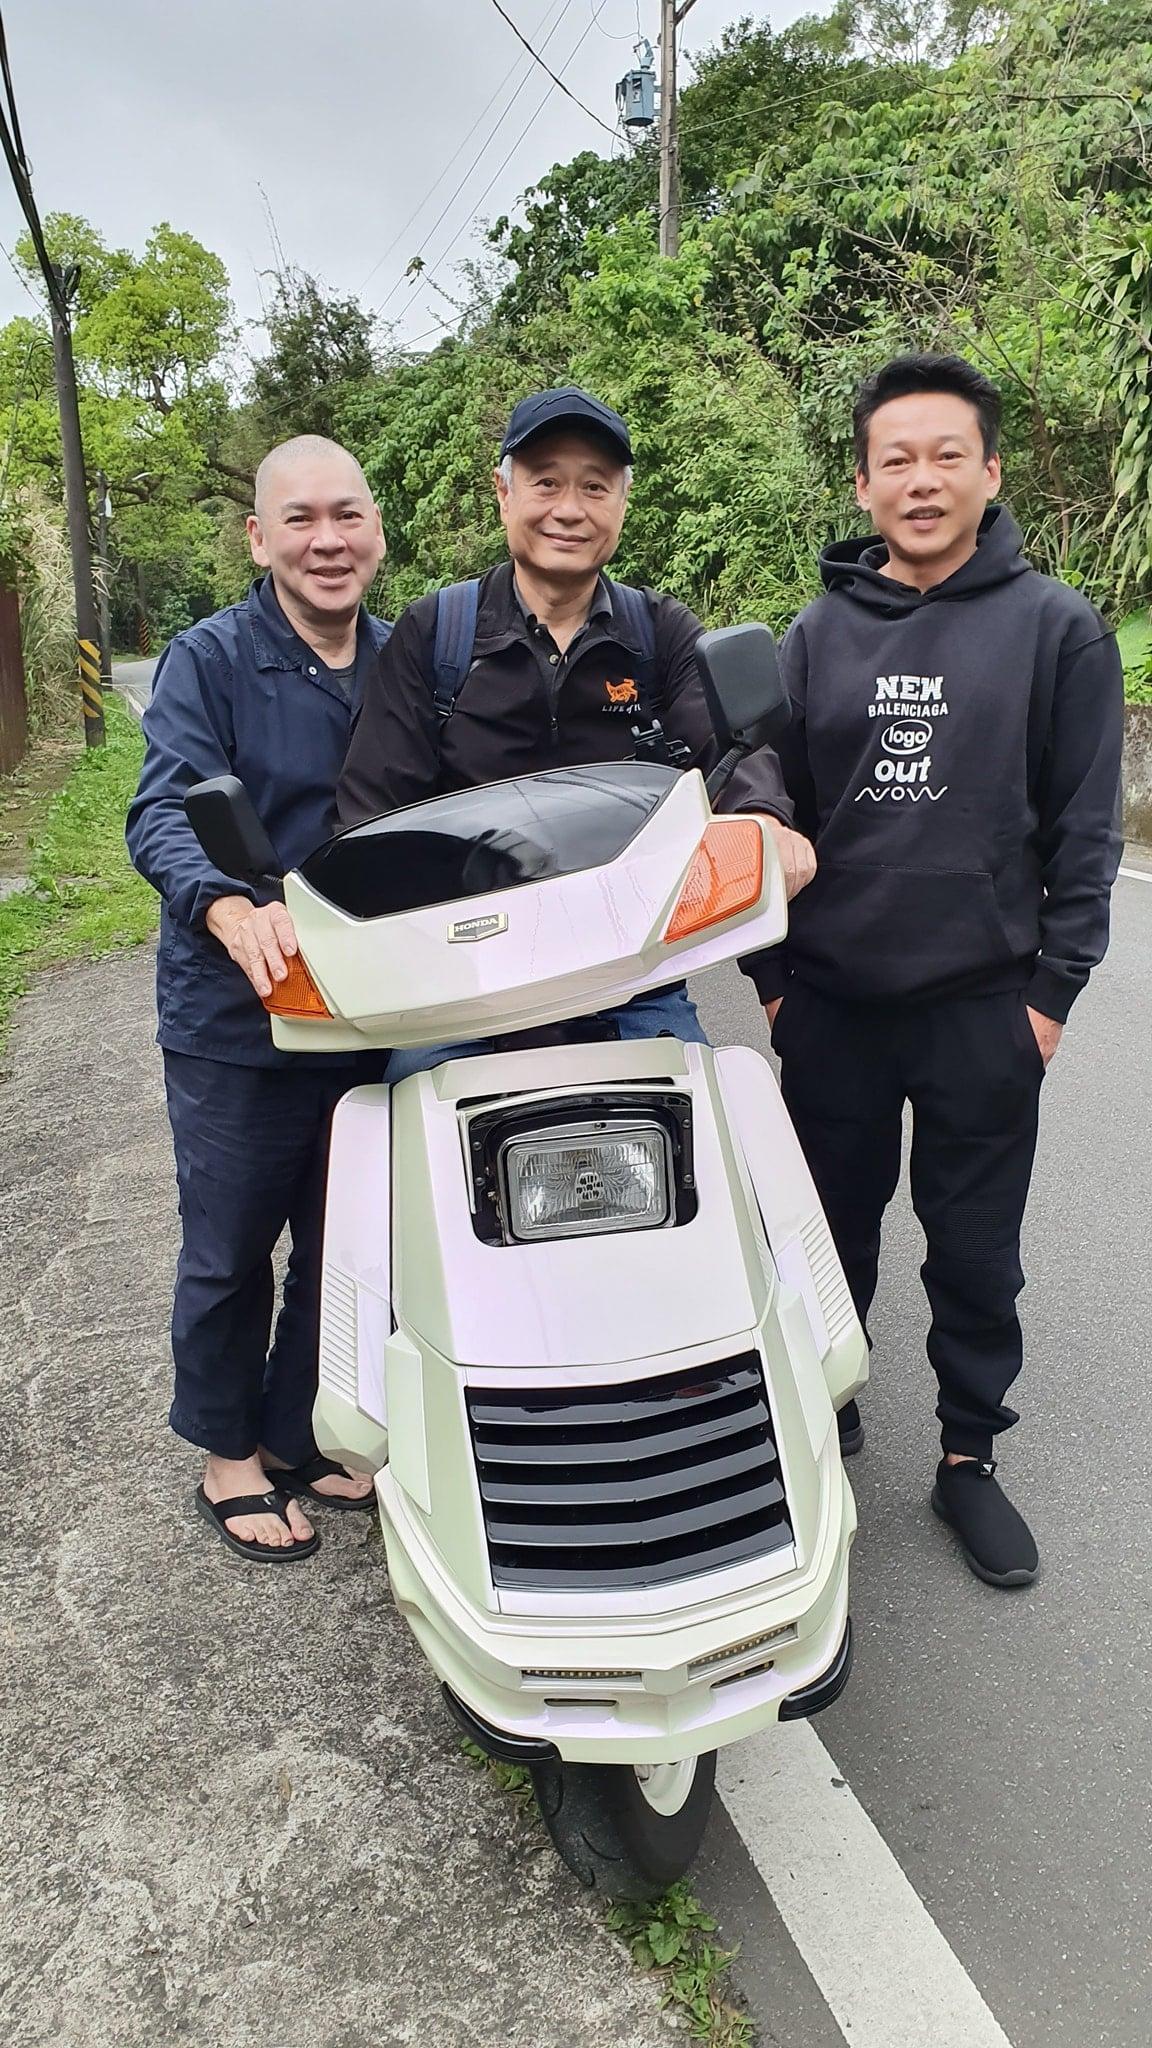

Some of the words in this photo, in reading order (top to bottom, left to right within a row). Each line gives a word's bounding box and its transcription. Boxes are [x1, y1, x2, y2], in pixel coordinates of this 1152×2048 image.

[875, 675, 944, 701] NEW
[867, 702, 949, 718] BALENCIAGA
[888, 725, 927, 748] logo
[874, 756, 931, 783] out
[454, 917, 498, 932] HONDA
